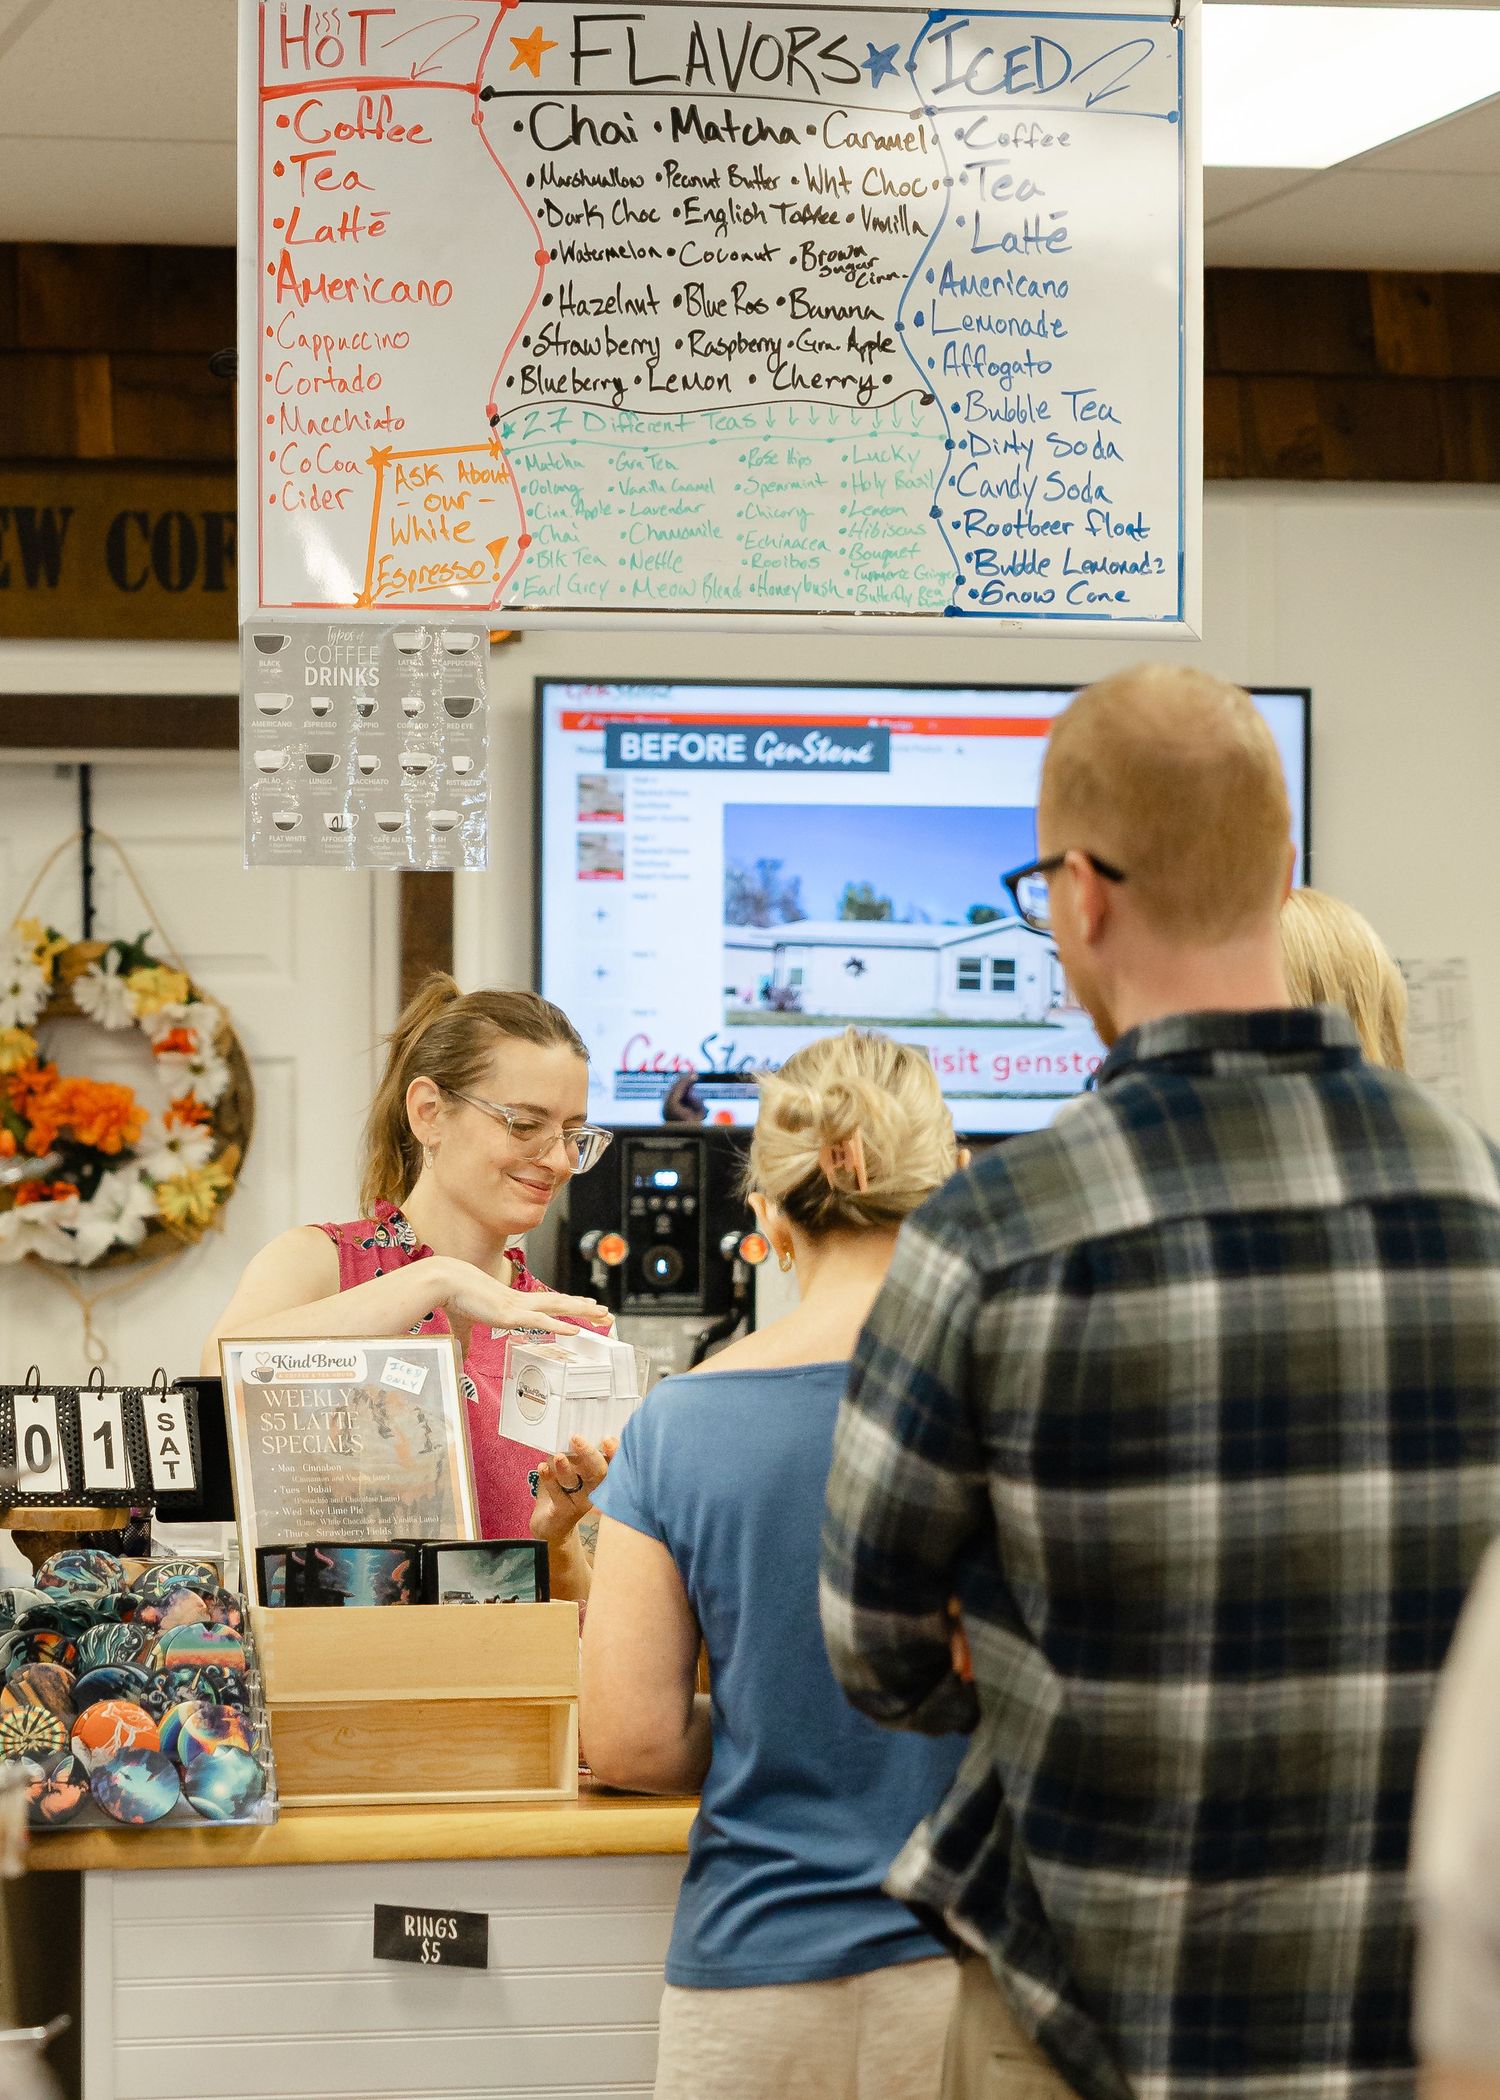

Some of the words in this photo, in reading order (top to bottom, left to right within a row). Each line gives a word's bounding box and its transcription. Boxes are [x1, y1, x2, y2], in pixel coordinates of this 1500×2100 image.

[280, 2, 396, 70] HOT
[570, 14, 861, 95] FLAVORS
[927, 19, 1072, 95] ICED
[294, 95, 432, 144] Coffee
[529, 101, 638, 151] Chai
[670, 104, 801, 146] Matcha
[823, 110, 927, 154] Caramel
[964, 115, 1071, 150] Coffee
[290, 150, 375, 197] Tea
[540, 161, 645, 190] Marshmallow
[663, 159, 721, 189] Peanut
[728, 163, 780, 191] Butter
[804, 162, 852, 199] Wht
[862, 167, 928, 197] Choc
[965, 159, 1045, 201] Tea
[544, 197, 604, 229] Dark
[612, 197, 661, 226] Choc
[683, 196, 767, 238] English
[769, 202, 840, 226] Toffee
[861, 203, 928, 237] Vanilla
[559, 239, 662, 265] Watermelon
[679, 241, 781, 267] Coconut
[799, 240, 868, 272] Brown
[276, 248, 453, 307] Americano
[939, 258, 1069, 299] Americano
[559, 279, 660, 318] Hazelnut
[683, 281, 728, 318] Blue
[789, 287, 884, 321] Banana
[932, 299, 1068, 338] Lemonade
[277, 311, 410, 361] Cappuccino
[532, 321, 661, 368] Strawberry
[688, 329, 781, 373] Raspberry
[847, 325, 896, 365] Apple
[275, 361, 382, 396] Cortado
[943, 340, 1052, 392] Affogato
[520, 364, 628, 408] Blueberry
[648, 366, 732, 393] Lemon
[773, 361, 879, 406] Cherry
[280, 402, 406, 435] Macchiato
[964, 390, 1051, 424] Bubble
[1061, 388, 1122, 424] Tea
[522, 407, 573, 440] 27
[583, 410, 696, 433] Different
[700, 410, 757, 431] Teas
[525, 452, 585, 471] Matcha
[645, 453, 679, 470] Tea
[748, 447, 779, 469] Rose
[967, 429, 1033, 472] Dirty
[1046, 429, 1124, 461] Soda
[458, 460, 510, 485] About
[619, 477, 667, 495] Vanilla
[671, 477, 715, 494] Caramel
[744, 472, 828, 498] Spearmint
[852, 470, 886, 499] Holy
[895, 469, 935, 490] Basil
[282, 481, 354, 511] Cider
[529, 480, 584, 507] Oolong
[956, 462, 1038, 515] Candy
[1043, 470, 1112, 504] Soda
[575, 498, 612, 520] Apple
[745, 502, 815, 532] Chicory
[848, 500, 907, 518] Lemon
[963, 508, 1074, 539] Rootbeer
[390, 516, 475, 546] White
[539, 522, 580, 545] Chai
[629, 520, 723, 544] Chamomile
[745, 530, 831, 551] Echinacea
[848, 518, 927, 539] Hibiscus
[537, 550, 567, 568] Blk
[575, 548, 607, 566] Tea
[630, 550, 682, 573] Nettle
[752, 553, 820, 568] Rooibos
[849, 542, 920, 568] Bouquet
[974, 548, 1051, 577] Bubble
[523, 574, 561, 598] Earl
[567, 573, 609, 597] Grey
[632, 576, 696, 597] Meow
[703, 572, 741, 603] Blend
[978, 579, 1055, 606] Snow
[1066, 580, 1130, 605] Cone
[327, 625, 354, 646] Types
[304, 645, 379, 665] COFFEE
[304, 666, 380, 687] DRINKS
[352, 721, 379, 729] OPPIO
[620, 732, 747, 763] BEFORE
[928, 1046, 979, 1073] isit
[263, 1389, 351, 1407] WEEKLY
[260, 1413, 286, 1432] $5
[293, 1411, 359, 1431] LATTE
[24, 1424, 51, 1473] 0
[93, 1421, 115, 1470] 1
[157, 1412, 181, 1480] SAT
[262, 1434, 363, 1454] SPECIALS
[303, 1464, 342, 1473] Cinnabon
[307, 1485, 331, 1493] Dubai
[310, 1507, 324, 1517] Key
[327, 1506, 348, 1515] Lime
[350, 1505, 363, 1514] Pie
[316, 1528, 365, 1538] Strawberry
[404, 1914, 458, 1940] RINGS
[421, 1938, 441, 1964] $5
